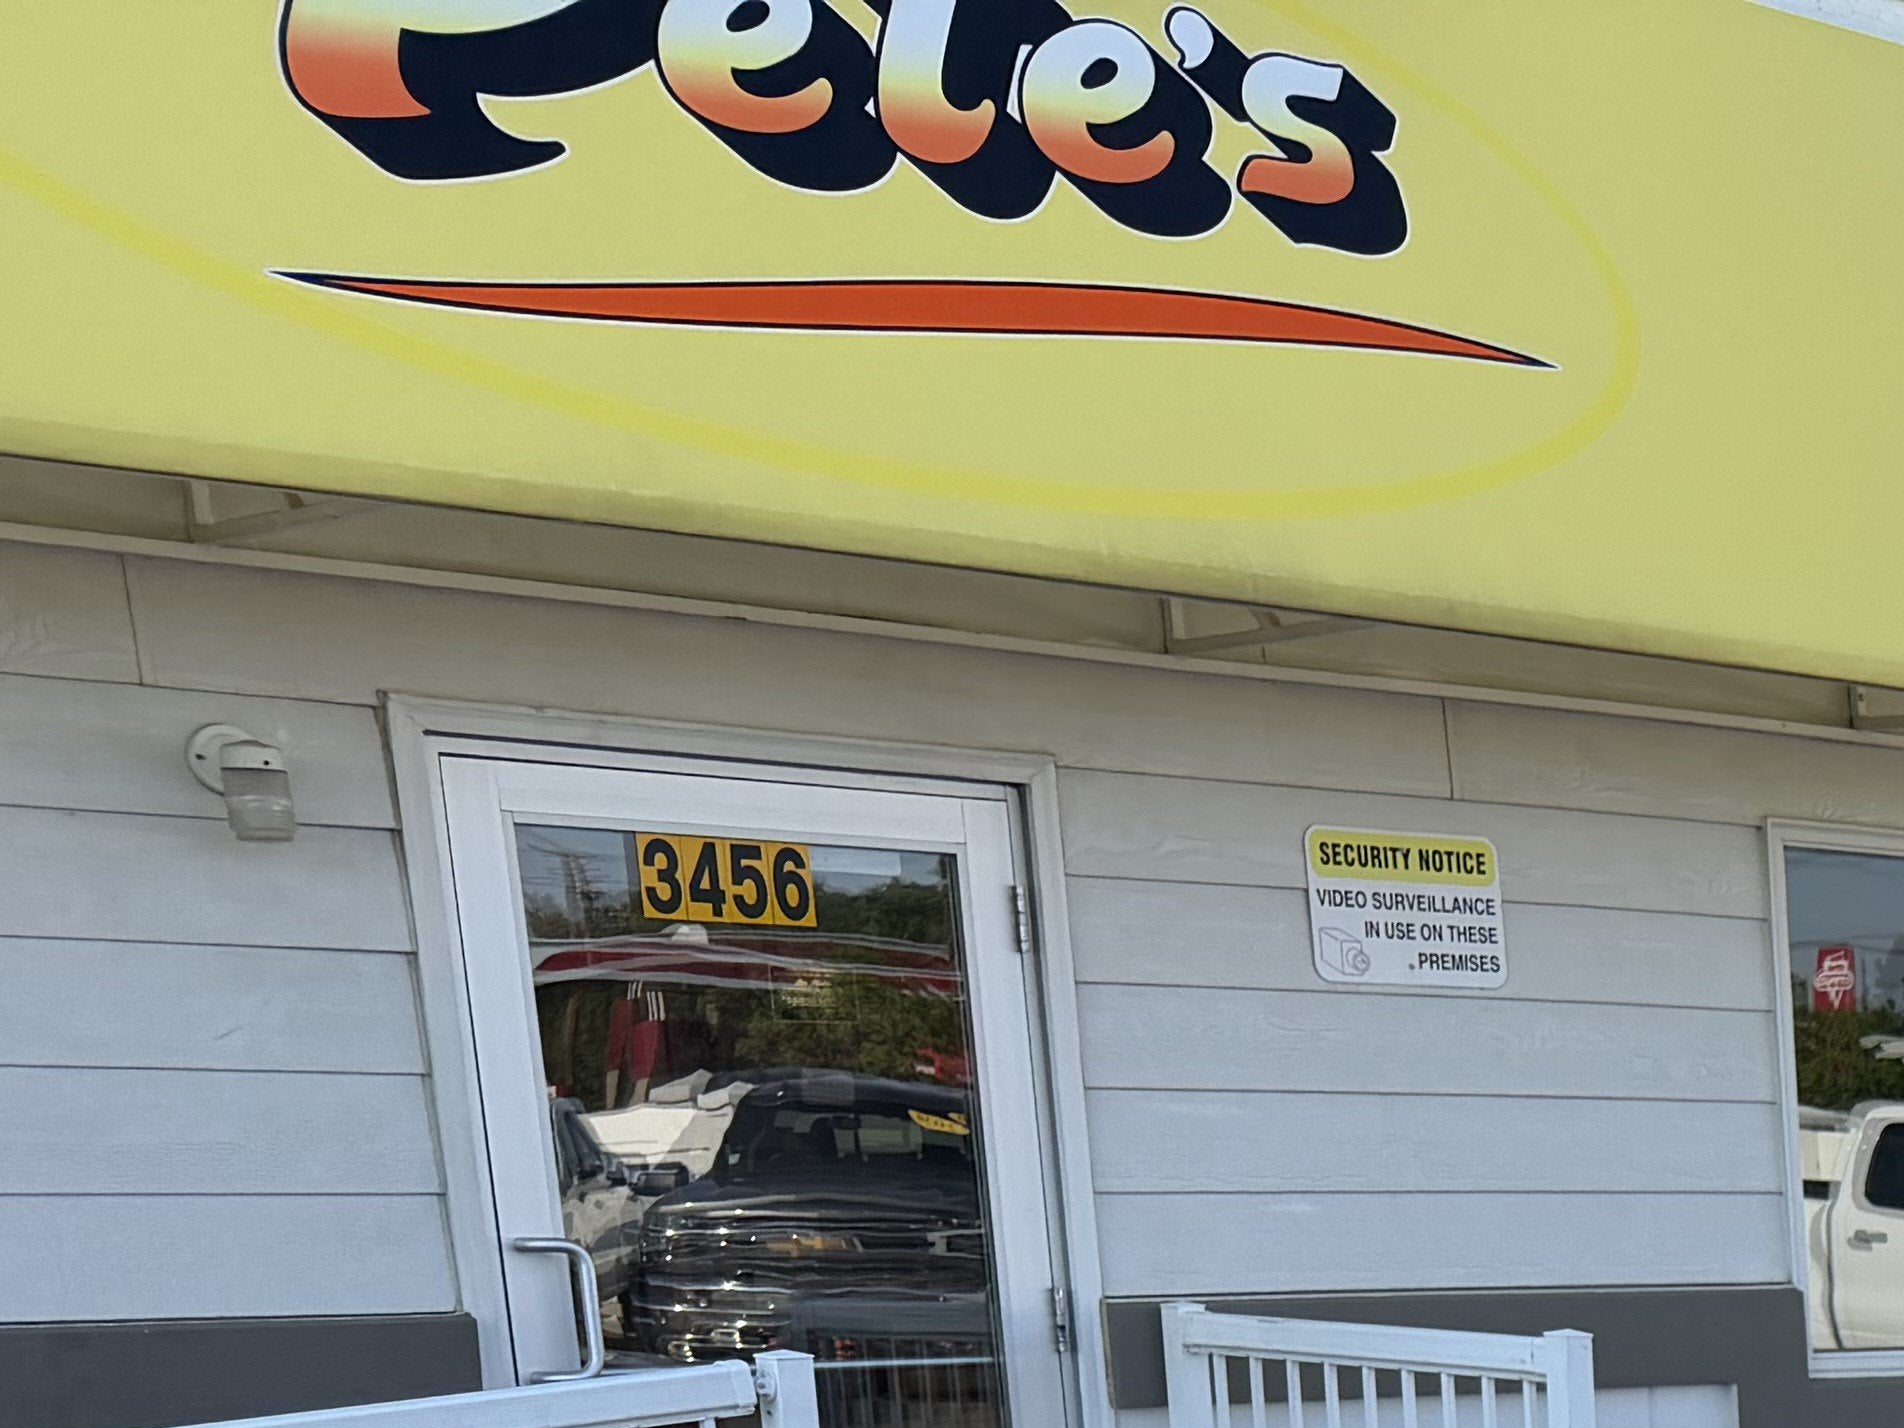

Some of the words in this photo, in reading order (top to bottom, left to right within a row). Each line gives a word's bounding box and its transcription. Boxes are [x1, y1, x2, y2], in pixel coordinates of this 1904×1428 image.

[1319, 841, 1411, 870] SECURITY
[1418, 848, 1487, 875] NOTICE
[641, 836, 813, 922] 3456
[1316, 888, 1367, 909] VIDEO
[1372, 892, 1496, 916] SURVEILLANCE
[1364, 920, 1381, 939] IN
[1384, 921, 1417, 940] USE
[1421, 923, 1443, 942] ON
[1447, 924, 1499, 944] THESE
[1418, 951, 1501, 973] PREMISES
